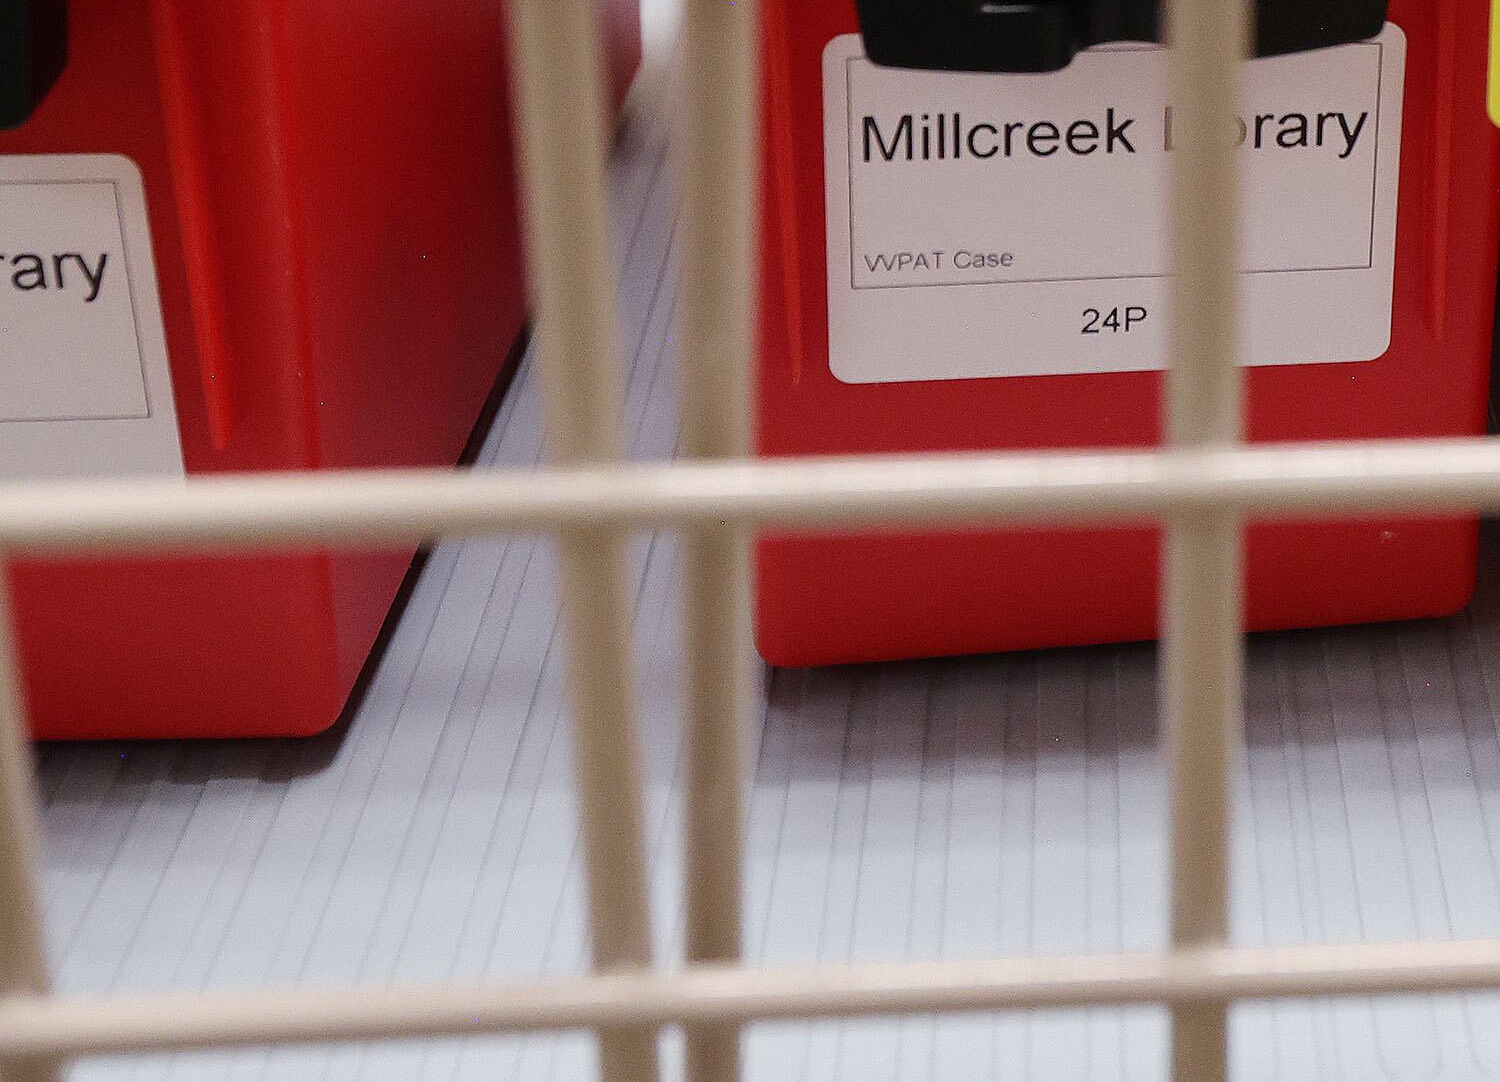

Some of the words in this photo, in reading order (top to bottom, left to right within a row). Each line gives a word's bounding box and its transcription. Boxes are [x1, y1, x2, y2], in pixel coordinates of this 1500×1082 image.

[861, 108, 1136, 163] Millcreek
[1163, 106, 1368, 159] Lrary
[0, 253, 107, 303] ary
[953, 249, 1014, 270] Case
[1081, 306, 1147, 334] 24P
